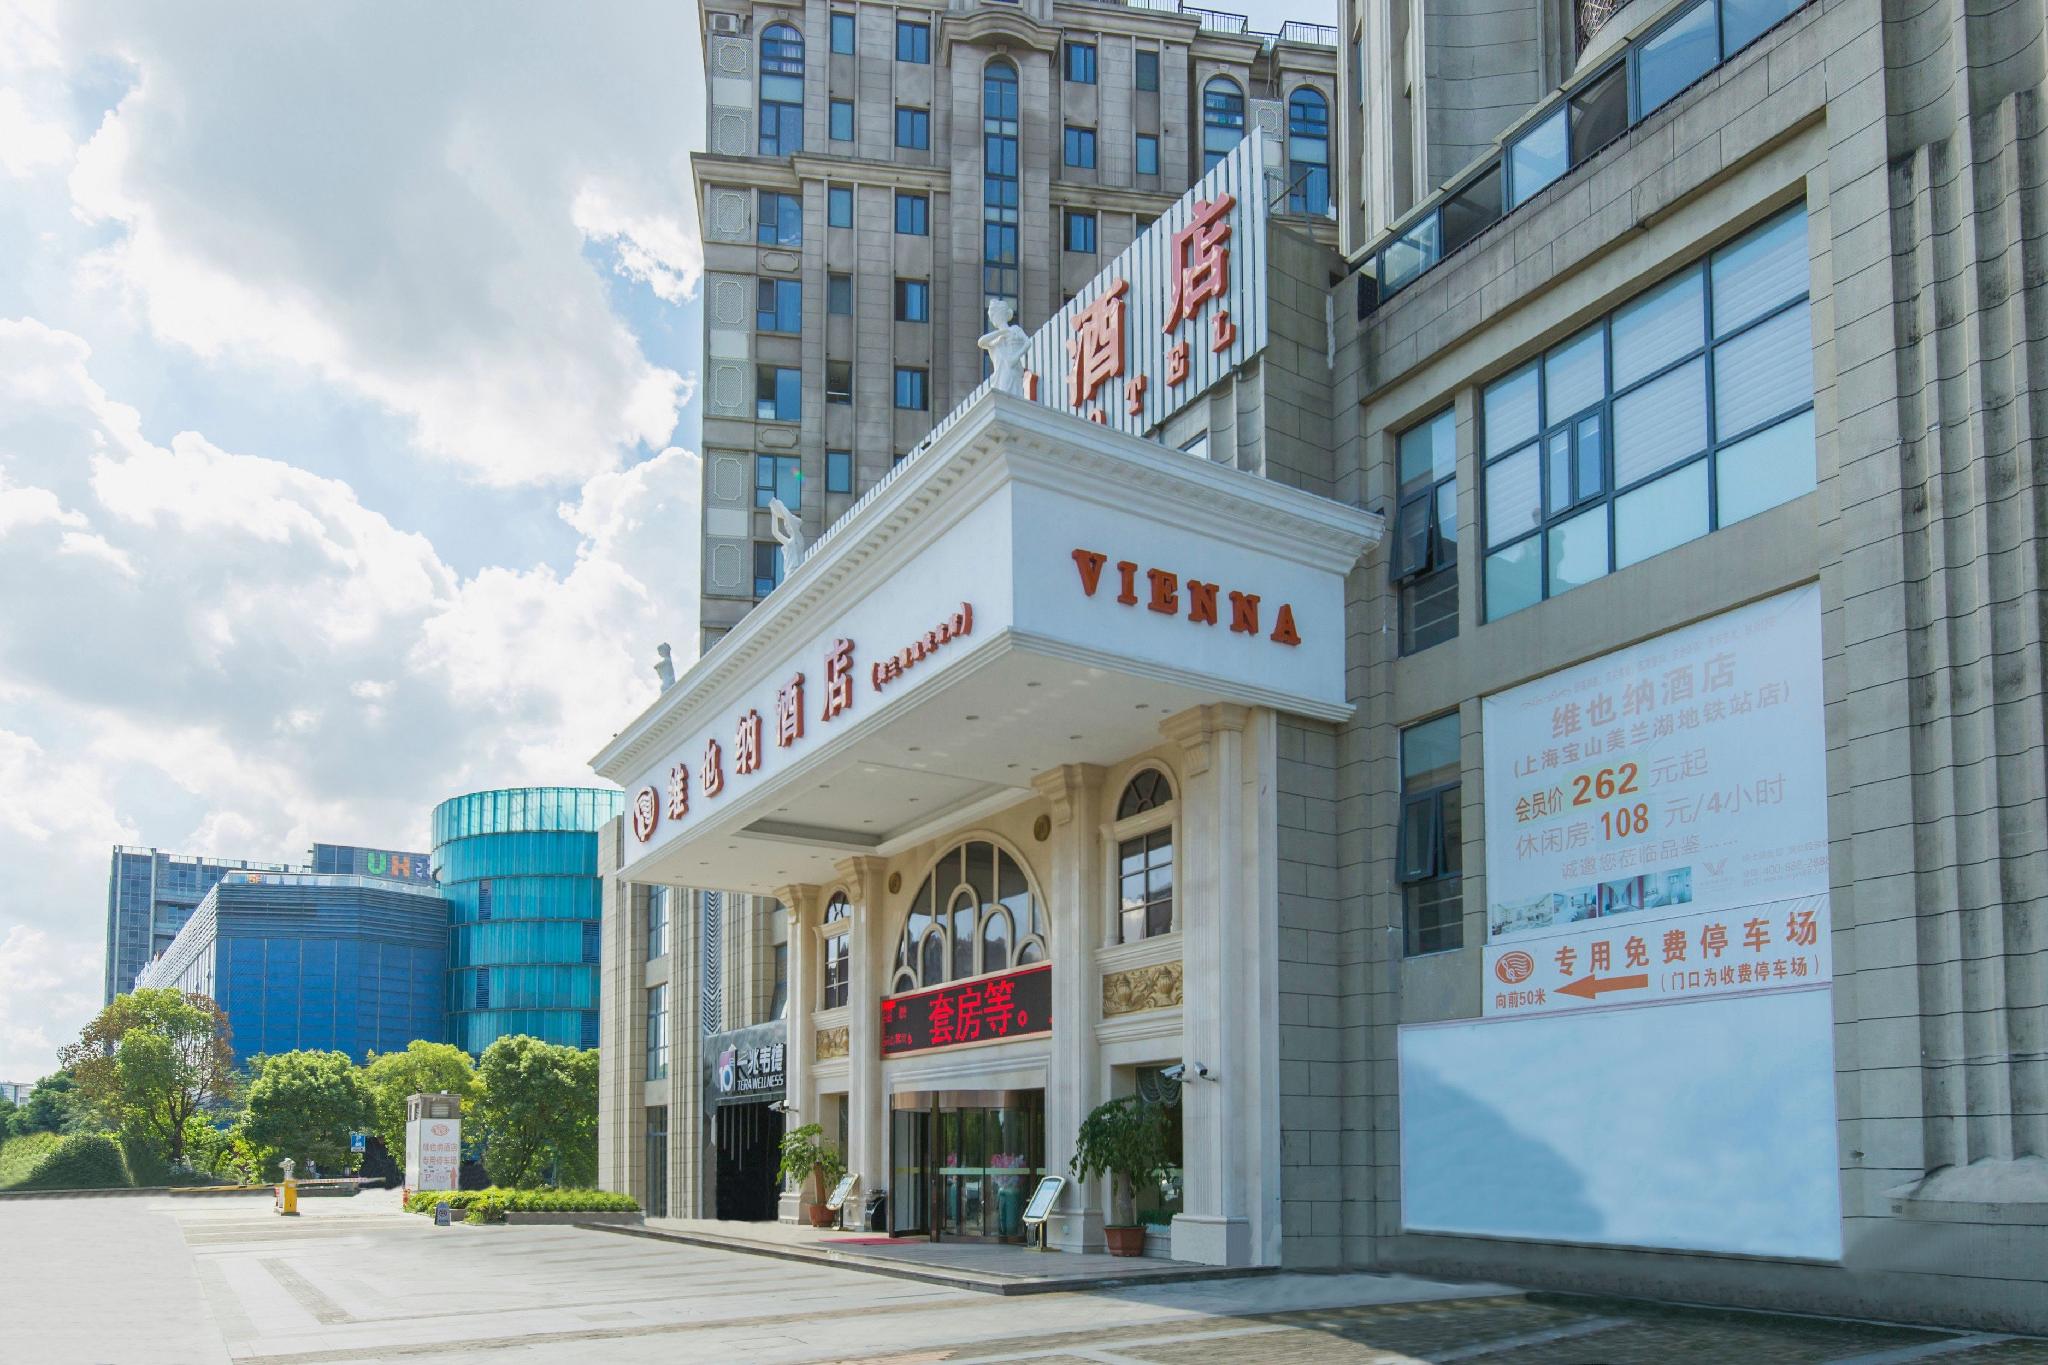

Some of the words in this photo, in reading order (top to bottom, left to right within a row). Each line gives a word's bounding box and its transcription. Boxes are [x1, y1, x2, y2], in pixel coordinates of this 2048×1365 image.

[1024, 192, 1236, 407] 酒店
[1072, 549, 1301, 646] VIENNA
[668, 638, 855, 820] 维也纳酒店
[1551, 651, 1738, 740] 维也纳酒店
[1515, 786, 1564, 823] 会员价
[1572, 762, 1638, 806] 262
[1600, 802, 1649, 841] 108
[1554, 910, 1818, 977] 专用免费停车场
[1495, 987, 1547, 1010] 向前50米
